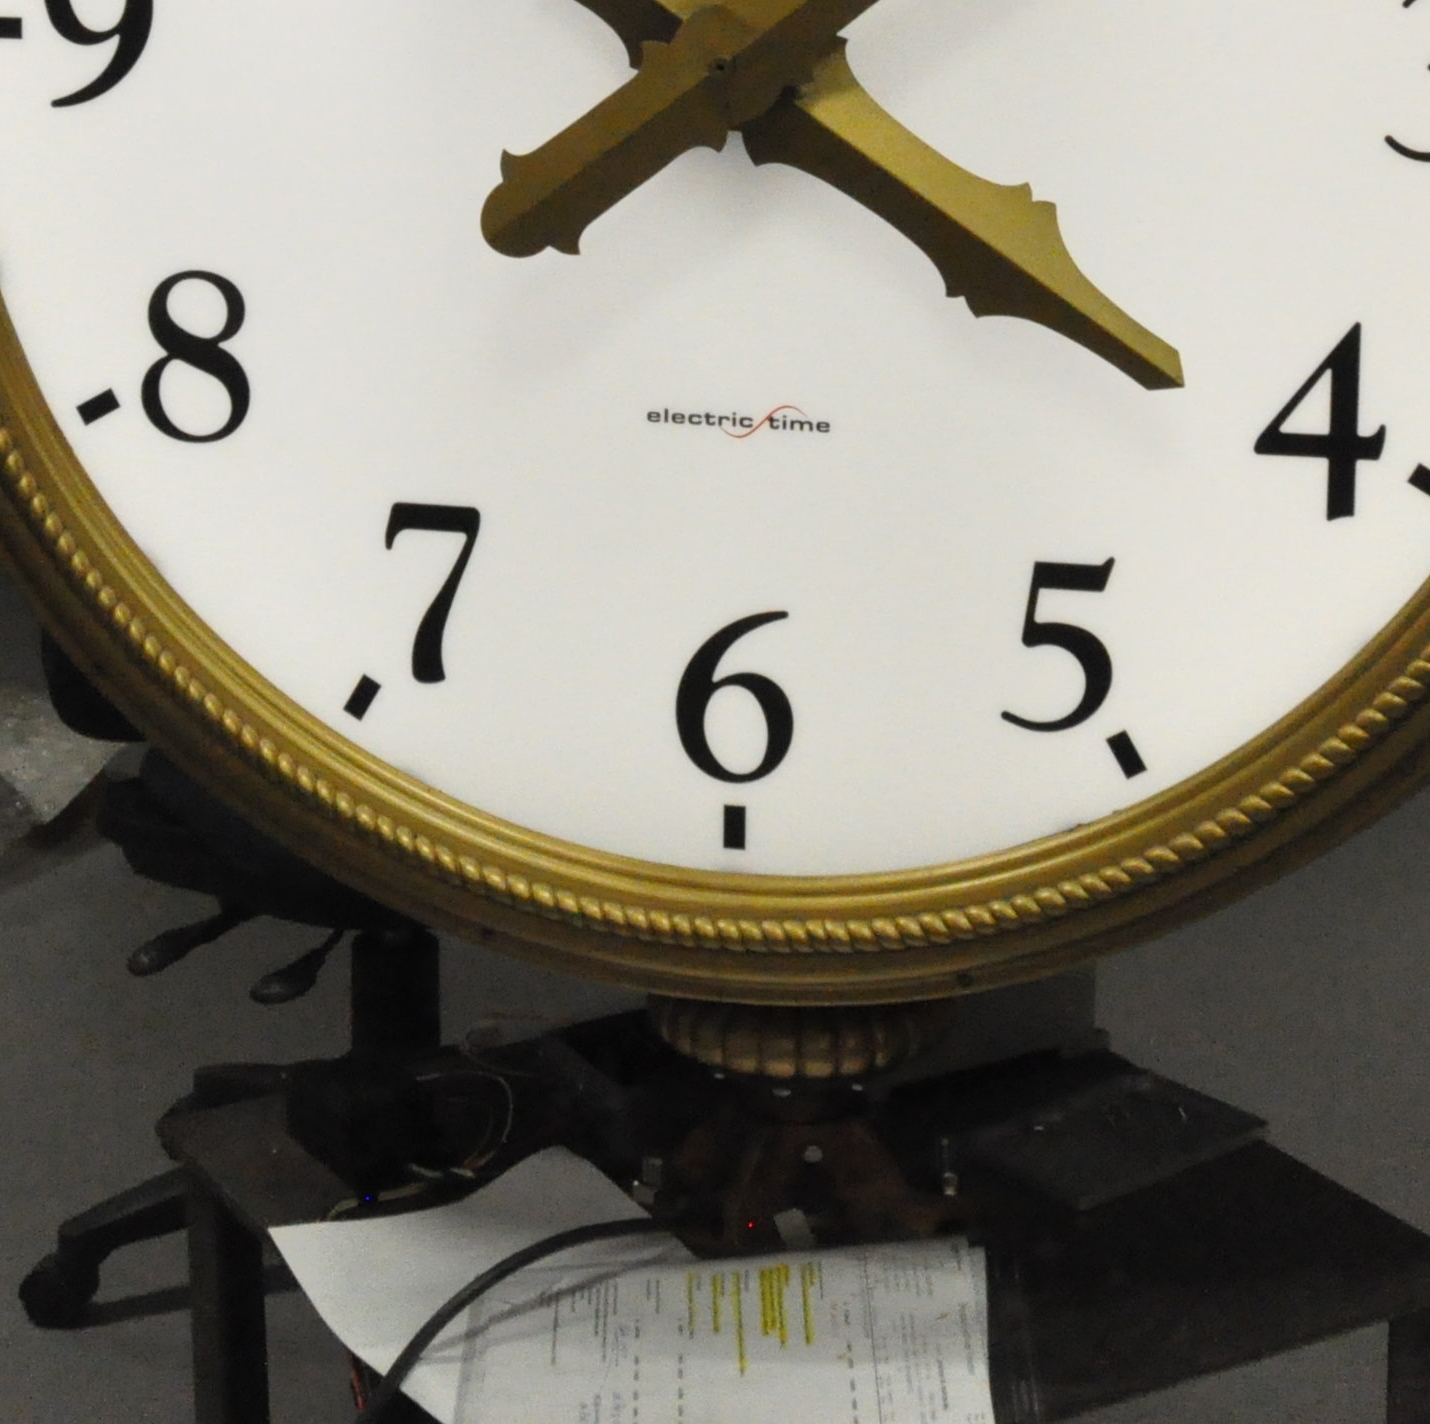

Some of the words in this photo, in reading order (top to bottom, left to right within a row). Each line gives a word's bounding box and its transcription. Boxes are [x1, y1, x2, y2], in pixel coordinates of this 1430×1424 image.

[141, 270, 251, 444] 8
[645, 407, 755, 429] electric
[766, 414, 832, 434] time
[1253, 322, 1386, 522] 4
[385, 502, 481, 684] 7
[1000, 557, 1115, 733] 5
[675, 610, 794, 784] 6
